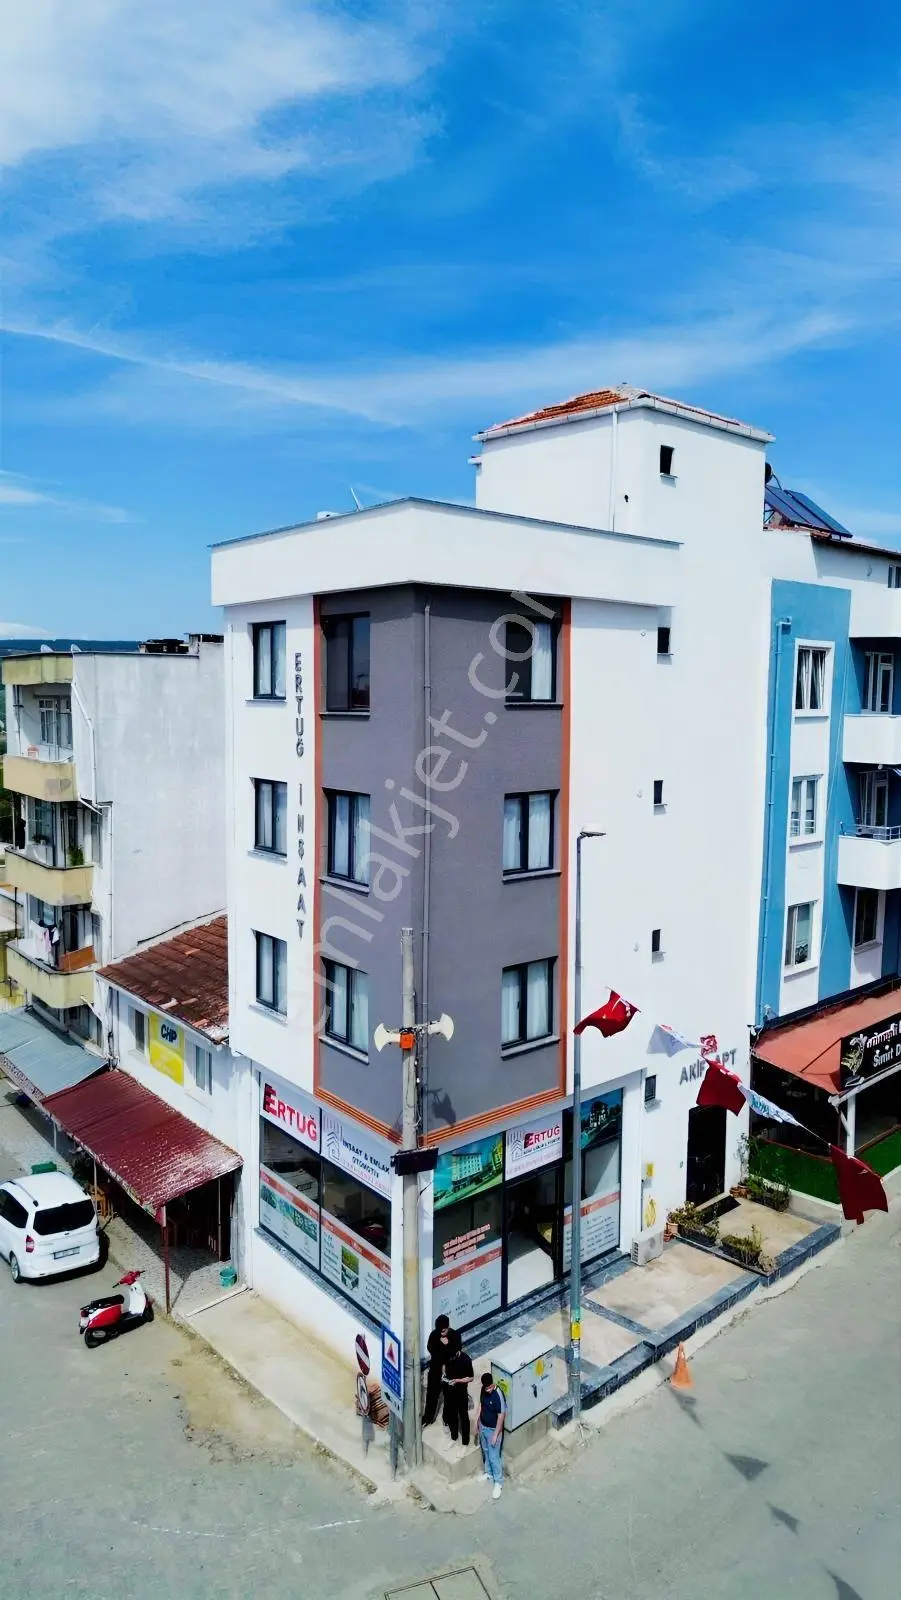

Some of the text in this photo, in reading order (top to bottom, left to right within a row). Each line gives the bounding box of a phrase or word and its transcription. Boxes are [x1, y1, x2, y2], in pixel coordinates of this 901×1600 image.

[294, 652, 305, 758] ERTUĞ
[160, 1023, 178, 1043] CHP
[263, 1083, 318, 1142] ERTUĞ
[523, 1125, 561, 1149] ERTUĞ
